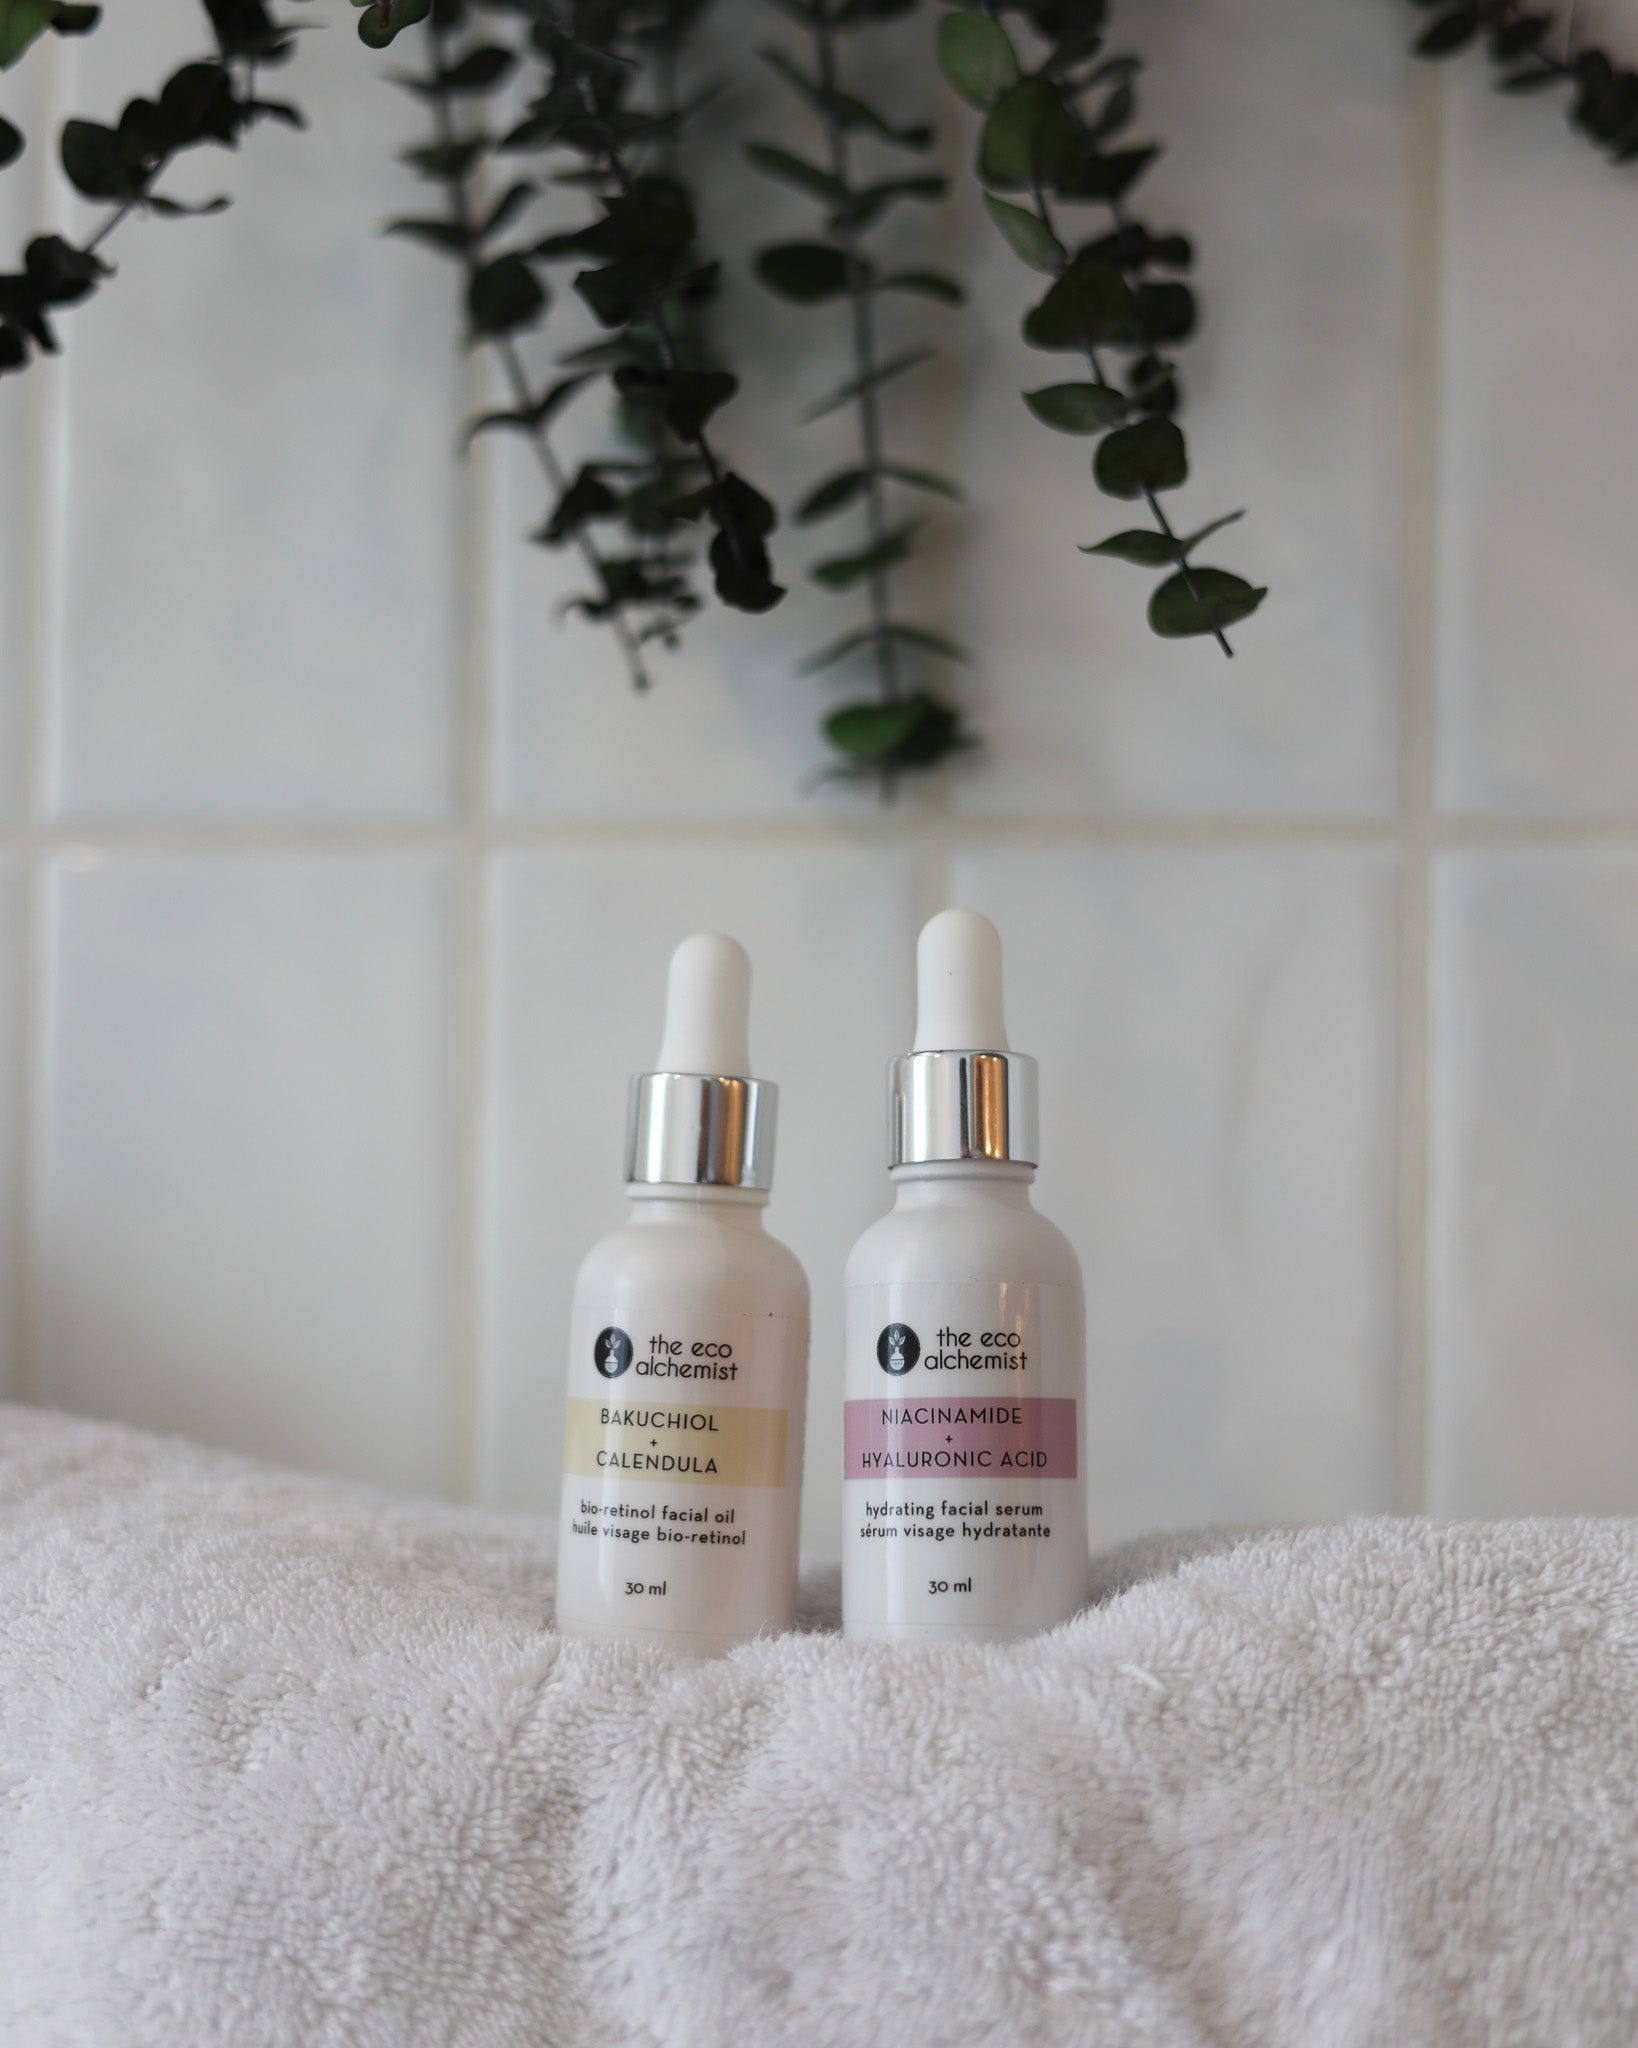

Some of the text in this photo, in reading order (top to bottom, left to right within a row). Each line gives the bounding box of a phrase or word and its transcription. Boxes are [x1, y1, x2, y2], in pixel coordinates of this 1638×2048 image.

[649, 1334, 732, 1358] the eco
[936, 1326, 1021, 1347] the eco
[635, 1357, 738, 1381] alchemist
[924, 1349, 1028, 1370] alchemist
[600, 1408, 719, 1431] BAKUCHIOL
[882, 1407, 1023, 1425] NIACINAMIDE
[650, 1438, 658, 1447] +
[945, 1435, 953, 1444] +
[596, 1450, 718, 1474] CALENDULA
[862, 1450, 1047, 1468] HYALURONIC ACID
[580, 1499, 735, 1524] bio-retinol facial oil
[866, 1500, 1043, 1519] hydrating facial serum
[572, 1519, 746, 1545] huile visage bio-retinol
[860, 1522, 1051, 1541] sérum visage hydratante
[625, 1581, 667, 1595] 30 ml
[928, 1577, 972, 1594] 30 ml
